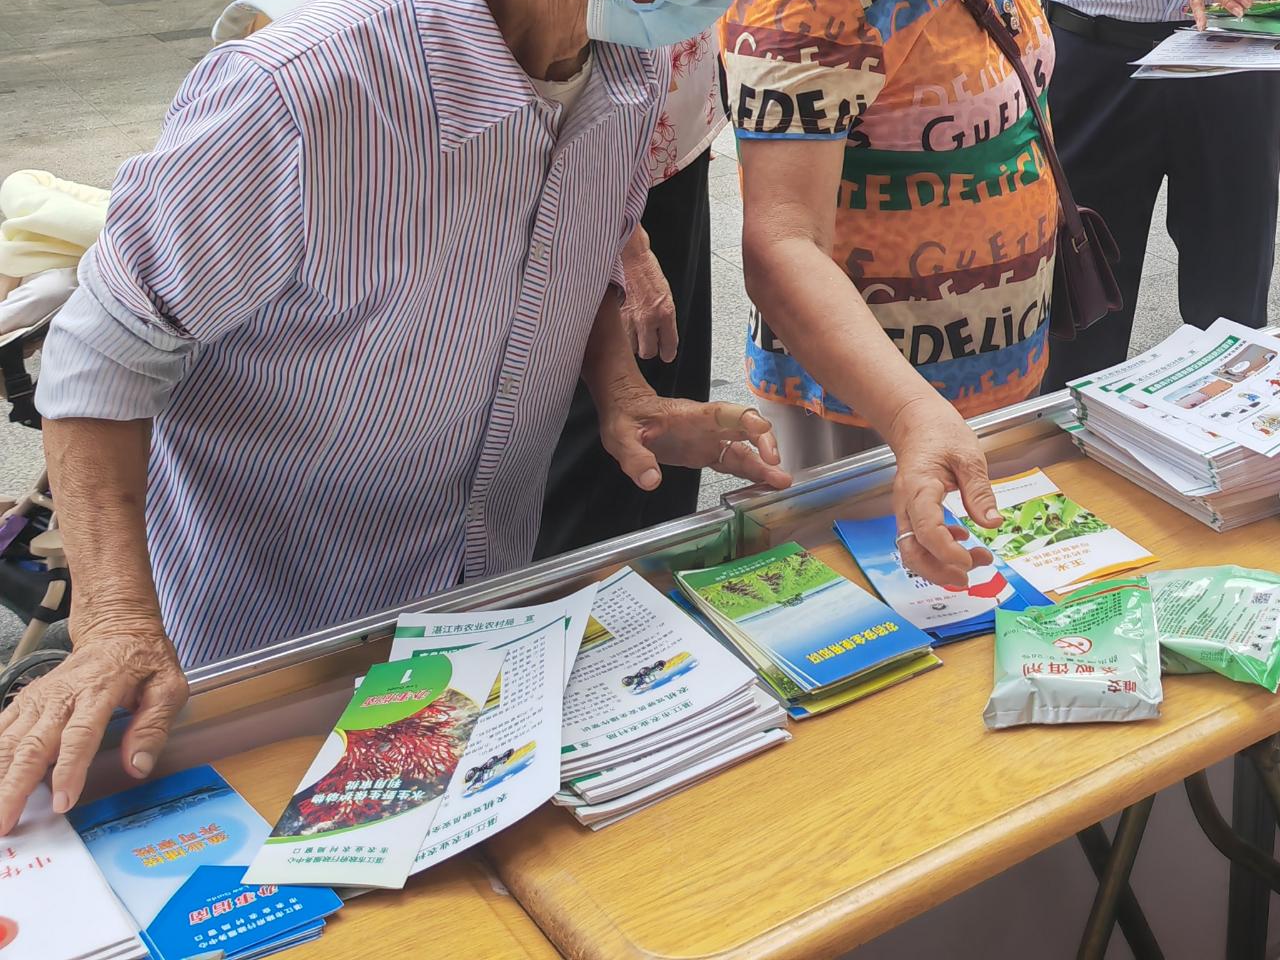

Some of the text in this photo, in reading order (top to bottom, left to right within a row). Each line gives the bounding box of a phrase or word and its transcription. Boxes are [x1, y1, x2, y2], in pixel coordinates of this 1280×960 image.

[431, 617, 515, 635] 湛江市农业农村局
[805, 621, 900, 665] 农药安全使用知识
[605, 699, 695, 742] 湛江市农业农村局
[345, 778, 403, 791] 利用审批
[310, 788, 428, 807] 水生野生保护动物
[292, 845, 390, 855] 市农业农村局窗口
[287, 855, 386, 865] 湛江市政府行政服务中心
[189, 884, 281, 927] 办事指南
[198, 902, 304, 950] 湛江市政府行政服务中心
